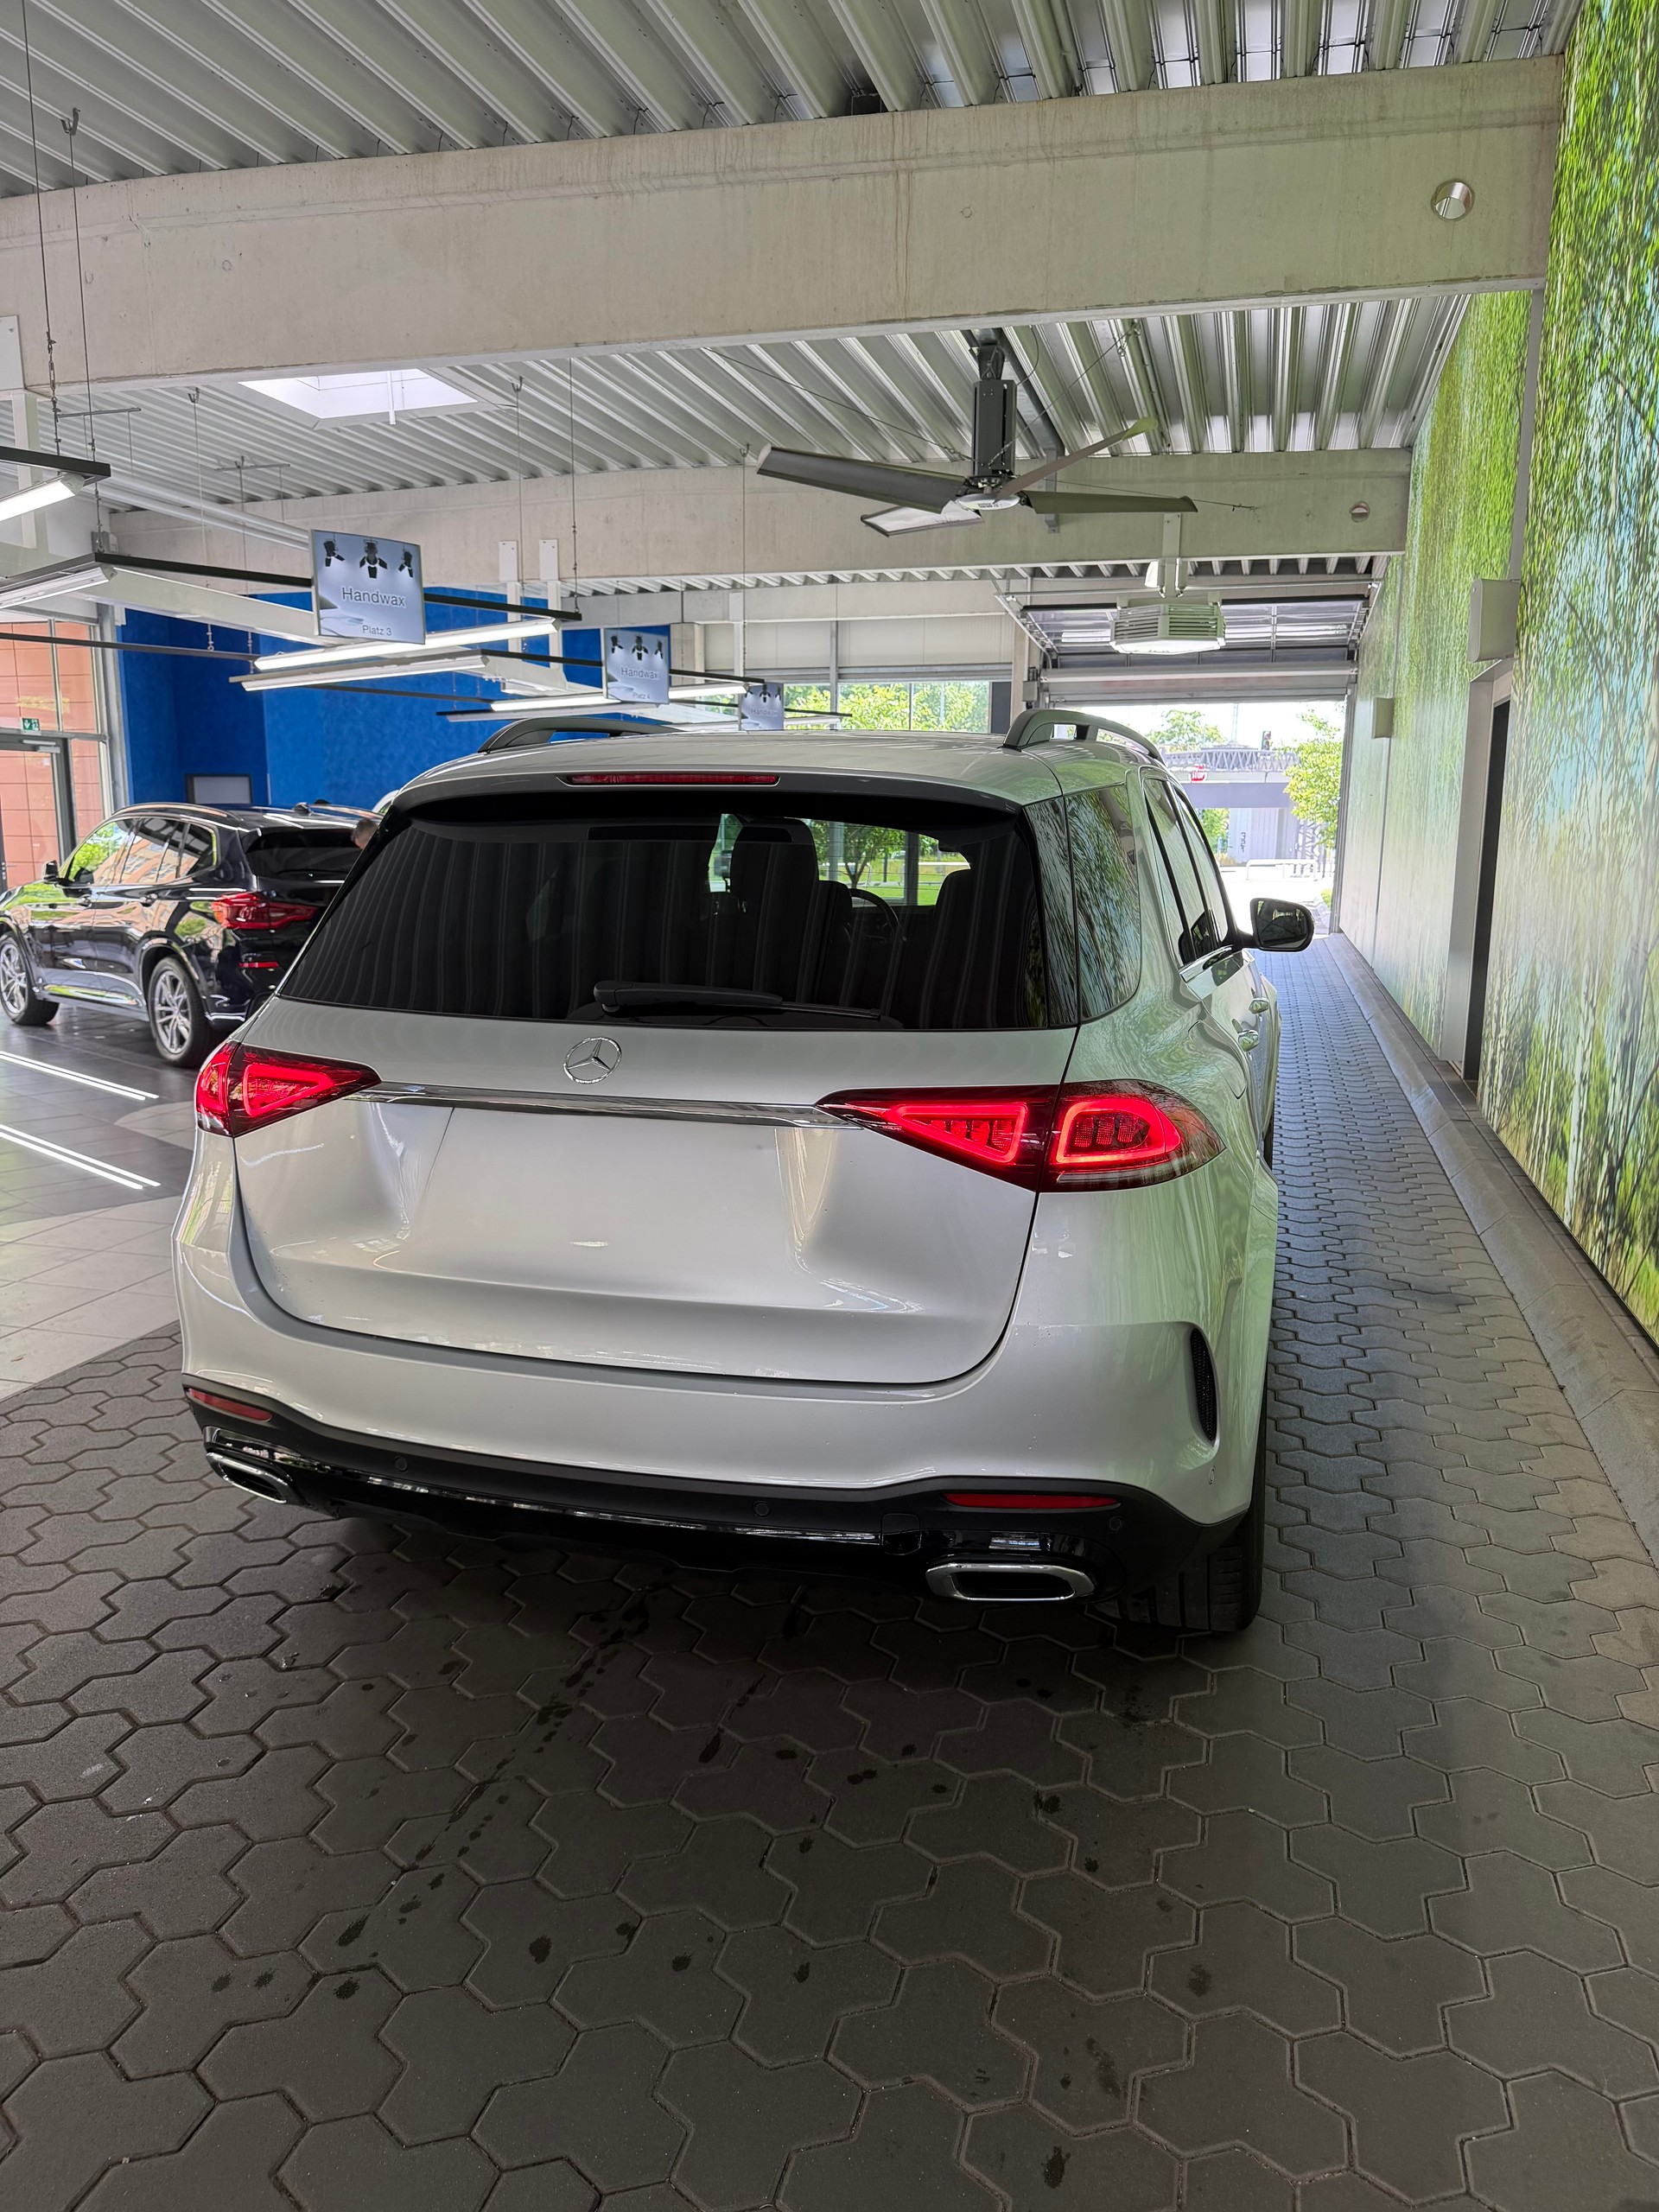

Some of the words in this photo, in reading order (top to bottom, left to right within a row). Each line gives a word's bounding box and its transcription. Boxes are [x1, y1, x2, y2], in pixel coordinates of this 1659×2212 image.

[341, 587, 406, 607] Handwax
[362, 625, 385, 635] Platz
[386, 627, 392, 636] 3
[620, 666, 659, 679] Handwax
